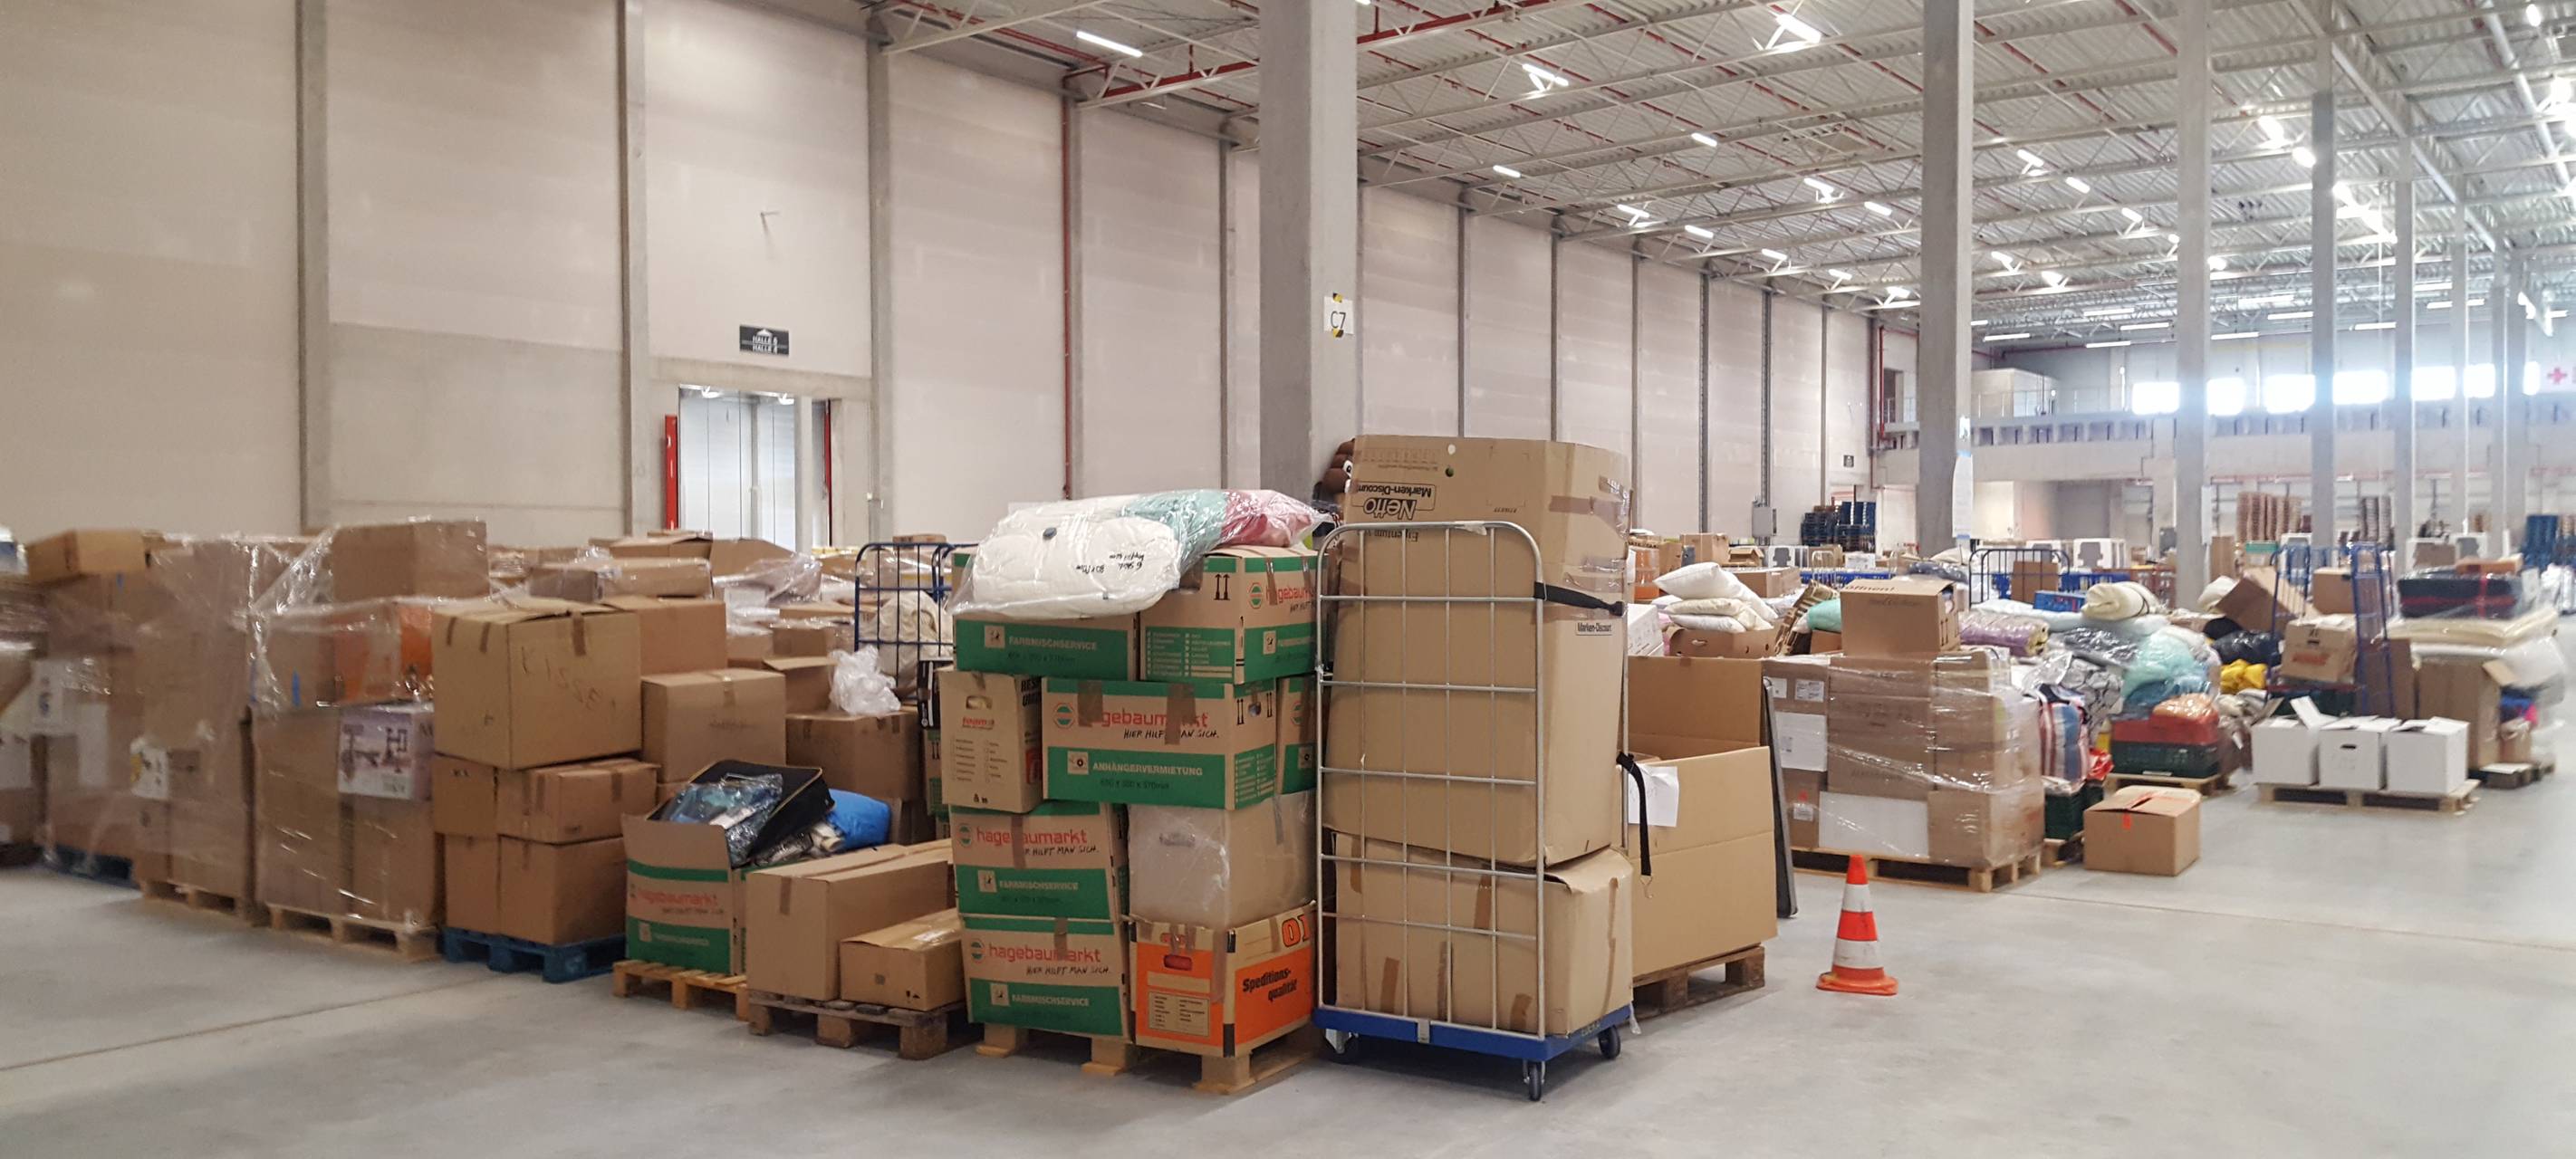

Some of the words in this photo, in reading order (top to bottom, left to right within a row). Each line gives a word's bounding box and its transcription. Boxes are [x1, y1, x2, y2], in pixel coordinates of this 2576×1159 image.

[1330, 311, 1347, 330] C7
[1363, 497, 1418, 521] Netto
[1123, 729, 1143, 740] HIER
[1145, 729, 1167, 740] HILF
[1179, 730, 1196, 739] AN
[1092, 761, 1204, 777] ANHÄNGERVERMIETUNG
[976, 827, 1089, 847] hageaumarkt
[1242, 968, 1292, 994] Speditions-
[1268, 980, 1298, 1001] qualität
